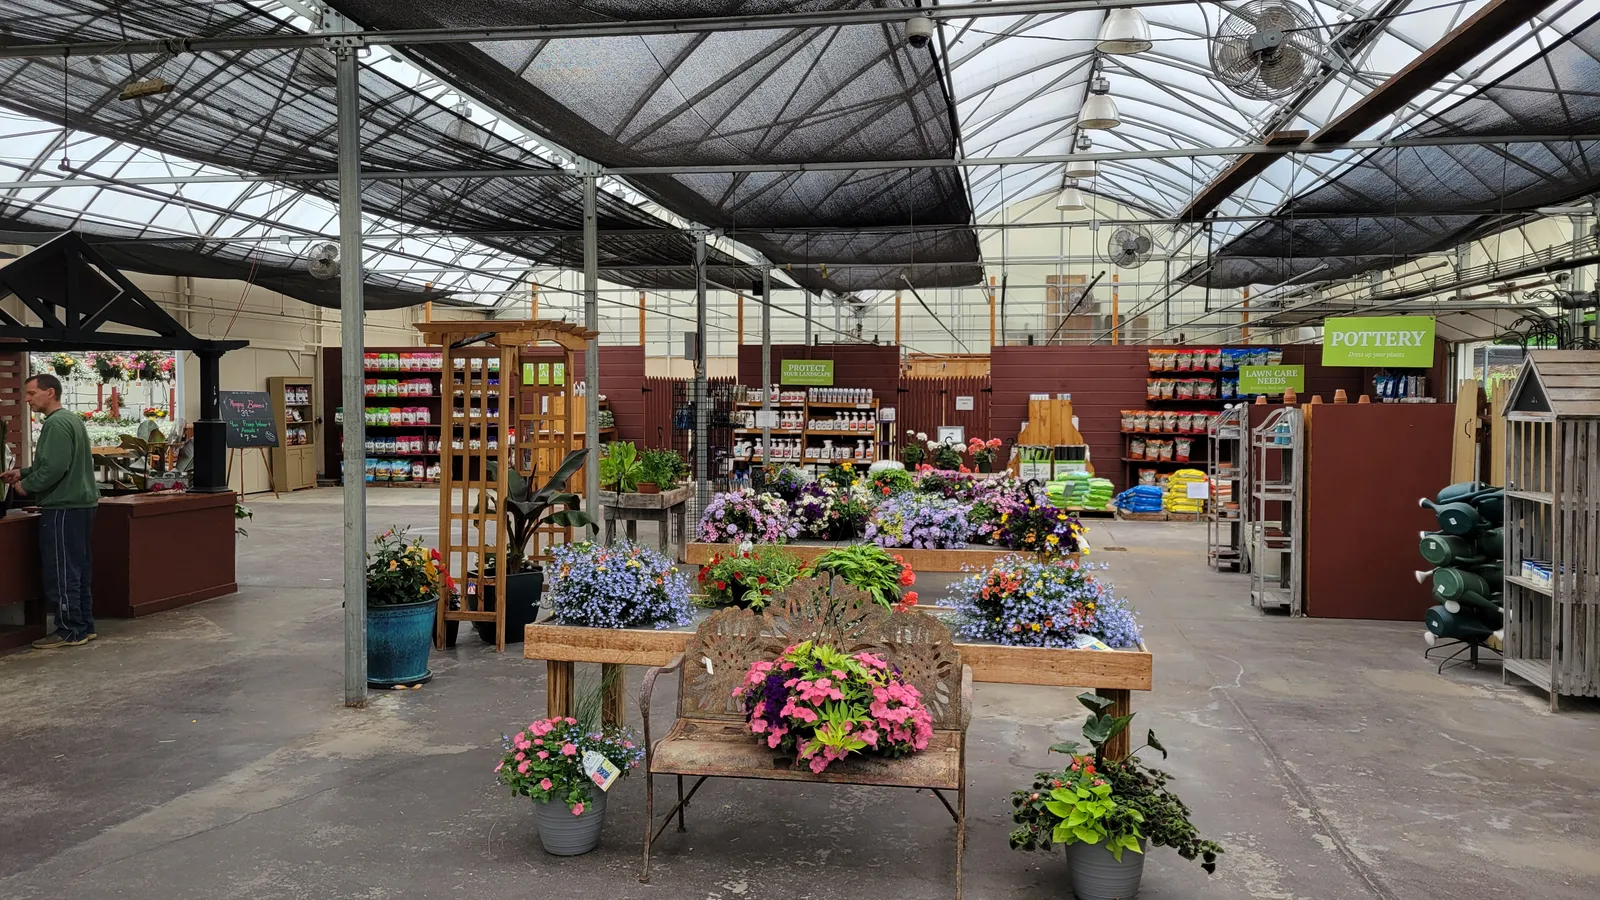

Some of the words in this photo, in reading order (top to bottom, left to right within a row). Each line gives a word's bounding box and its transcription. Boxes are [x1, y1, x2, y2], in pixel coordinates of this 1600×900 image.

[1330, 330, 1427, 347] POTTERY
[1386, 351, 1405, 359] plants
[788, 364, 827, 372] PROTECT
[1274, 369, 1298, 377] CARE
[1257, 377, 1286, 385] NEEDS
